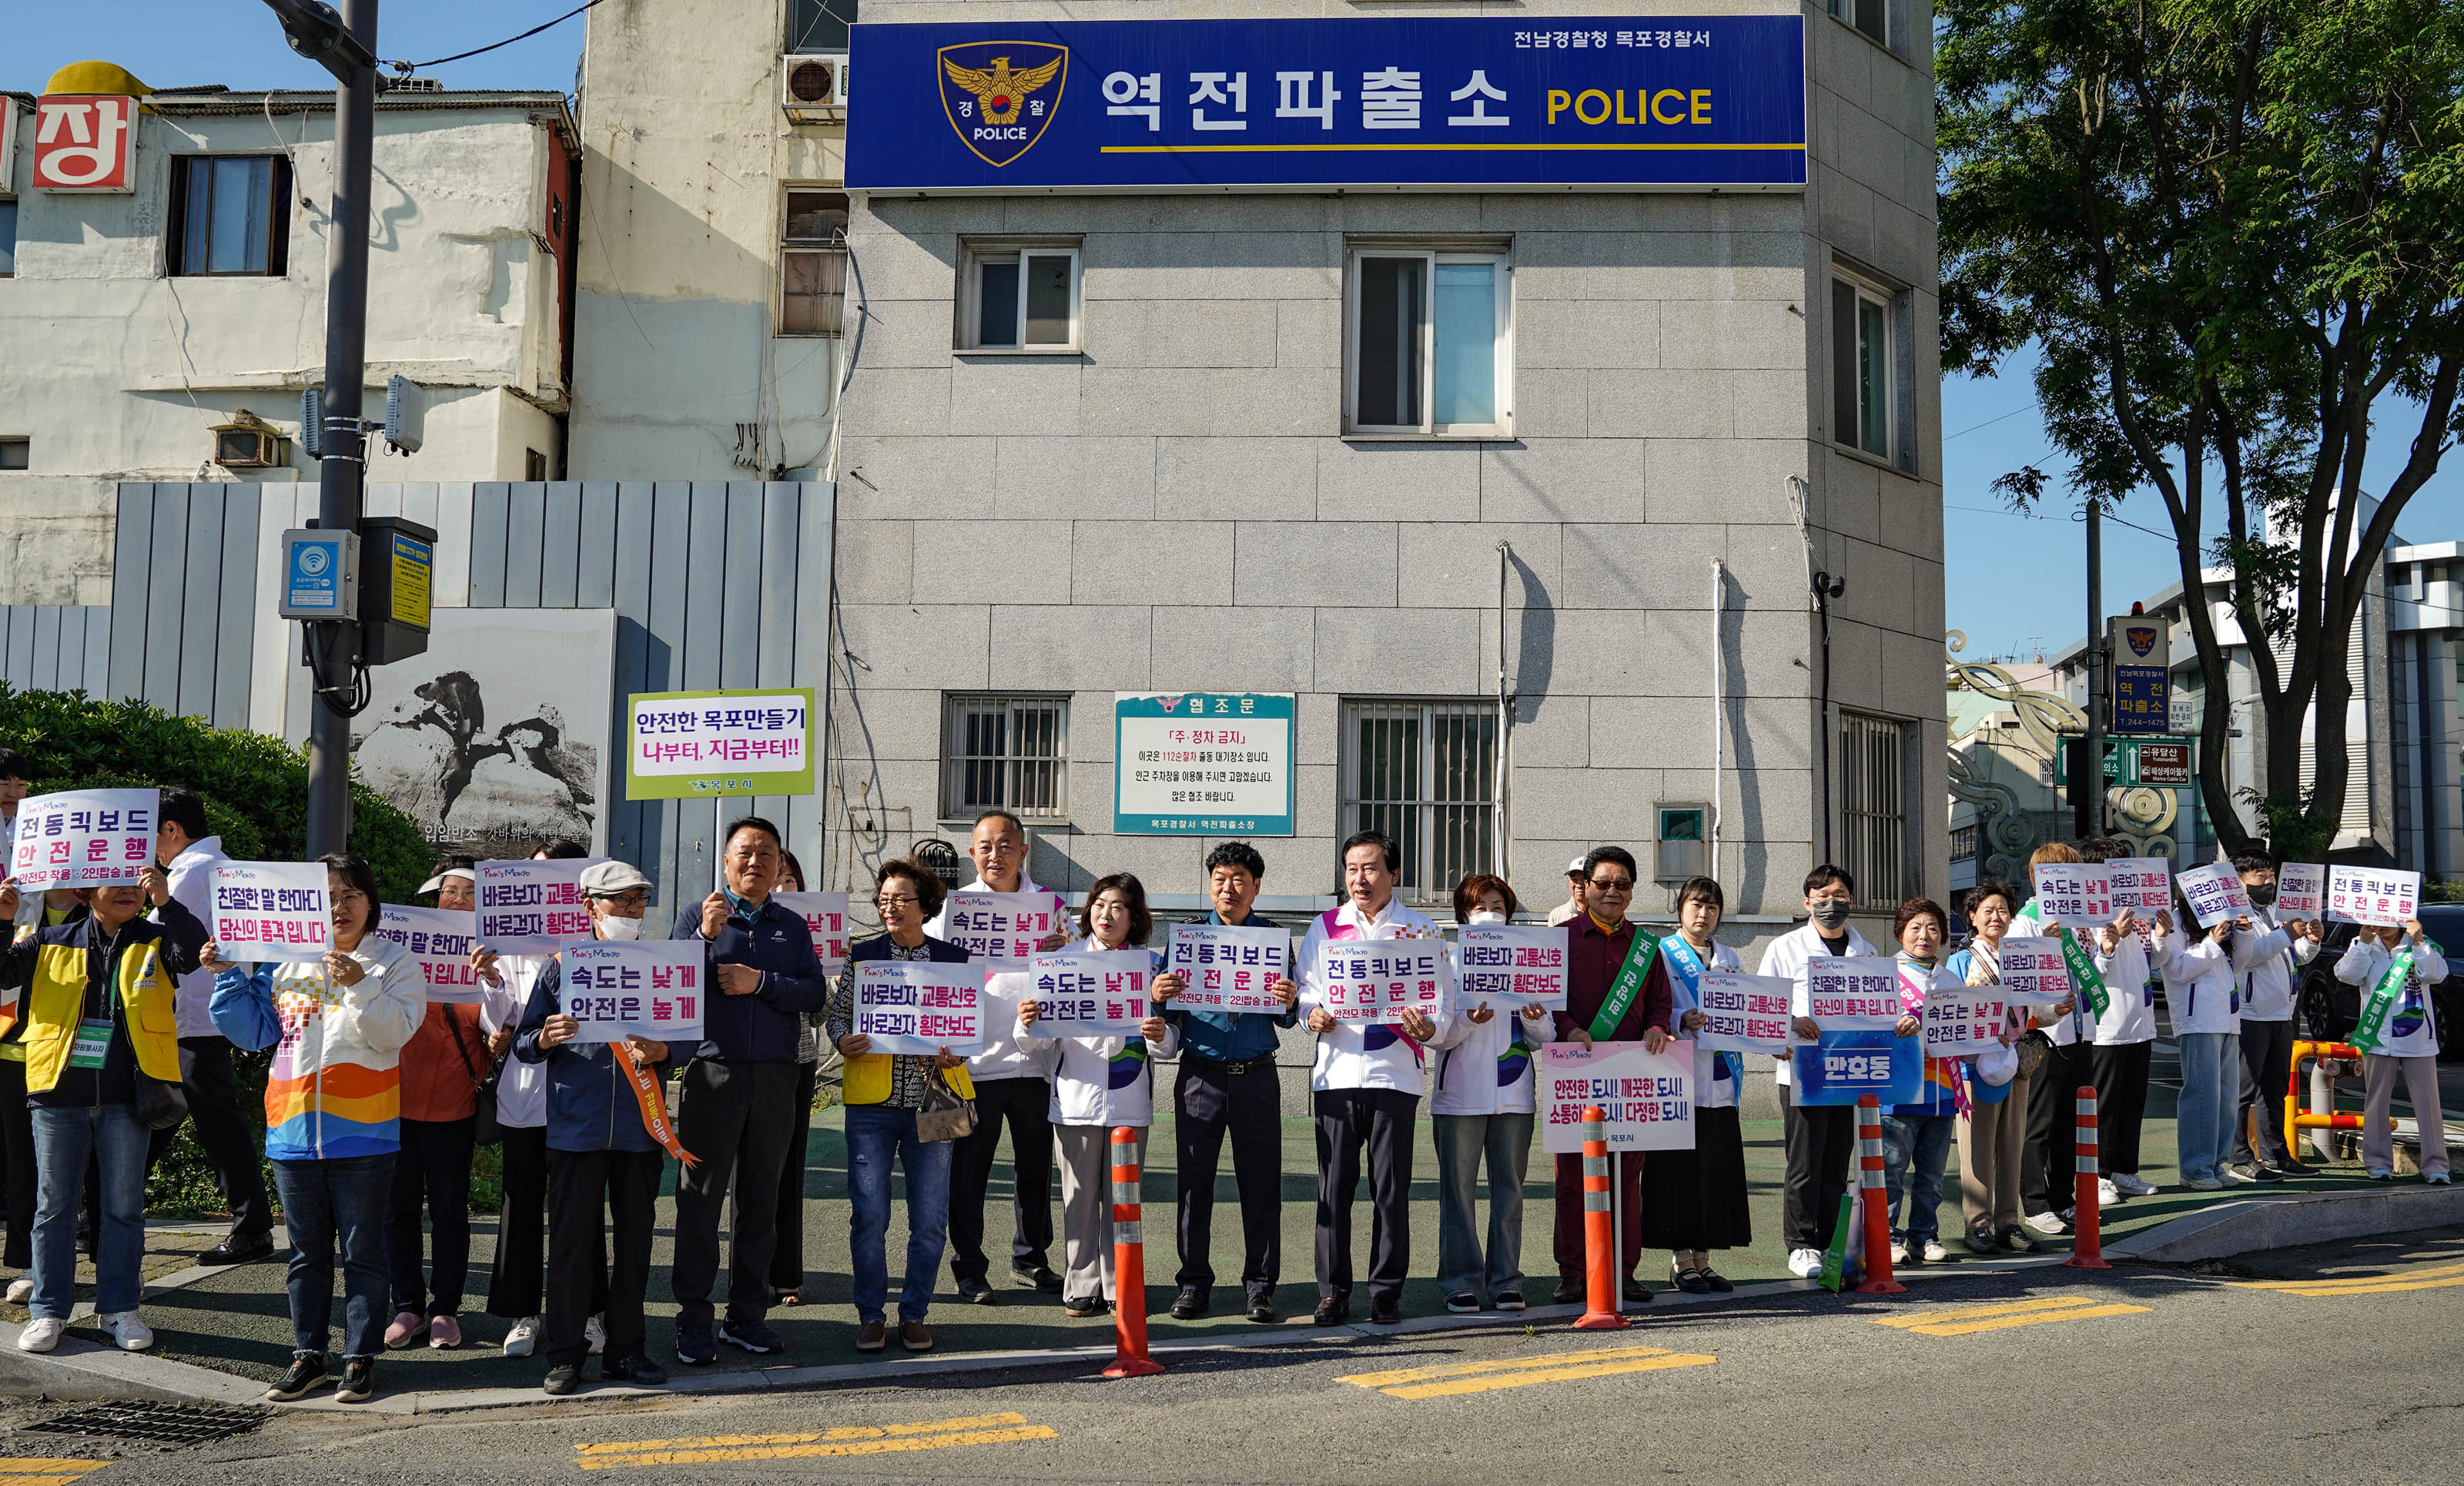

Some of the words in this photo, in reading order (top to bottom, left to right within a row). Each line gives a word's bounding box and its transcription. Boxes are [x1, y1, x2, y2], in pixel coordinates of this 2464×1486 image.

[1515, 31, 1608, 49] 전남경찰청
[1616, 31, 1709, 48] 목포경찰서
[959, 102, 972, 117] 경
[1030, 100, 1045, 115] 찰
[1548, 89, 1711, 125] POLICE
[974, 127, 1026, 140] POLICE
[1190, 698, 1254, 714] 협조문
[2120, 699, 2163, 713] 파출소
[637, 711, 698, 734] 안전한
[703, 708, 805, 731] 목포만들기
[643, 742, 703, 762] 나부터,
[709, 738, 798, 761] 지금부터!!
[1139, 751, 1160, 762] 이곳은
[1163, 751, 1197, 762] 112순찰차
[1200, 751, 1213, 762] 출동
[1216, 751, 1244, 763] 대기장소
[1247, 752, 1270, 763] 입니다.
[2151, 748, 2178, 757] 유달산
[1136, 771, 1149, 781] 인근
[1152, 771, 1179, 782] 주차장을
[1182, 771, 1203, 782] 이용해
[1206, 771, 1226, 782] 주시면
[1229, 771, 1272, 782] 고맙겠습니다.
[1172, 792, 1185, 802] 많은
[1188, 792, 1202, 802] 협조
[1205, 792, 1236, 802] 바랍니다.
[21, 810, 148, 841] 전동킥보드
[1151, 820, 1196, 828] 목포경찰서
[1201, 820, 1255, 829] 역전파출소장
[50, 869, 71, 881] 착용
[2111, 873, 2139, 888] 바로보자
[2140, 872, 2167, 887] 교통신호
[2282, 878, 2304, 892] 친절한
[483, 884, 542, 907] 바로보자
[2041, 879, 2081, 895] 속도는
[2085, 879, 2108, 895] 낮게
[2185, 879, 2220, 899] 바로보자
[2335, 879, 2413, 897] 전동킥보드
[218, 887, 259, 910] 친절한
[261, 888, 276, 911] 말
[279, 889, 322, 912] 한마디
[2044, 899, 2082, 915] 안전은
[2087, 899, 2109, 915] 높게
[2111, 892, 2141, 908] 바로걷자
[2142, 892, 2168, 907] 횡단보도
[2194, 895, 2228, 916] 바로걷자
[2278, 895, 2299, 910] 당신의
[219, 919, 259, 942] 당신의
[261, 919, 286, 942] 품격
[286, 921, 325, 944] 입니다
[483, 914, 543, 936] 바로걷자
[547, 912, 591, 935] 횡단보
[952, 912, 1007, 932] 속도는
[1016, 912, 1048, 932] 낮게
[411, 932, 429, 954] 말
[1176, 942, 1282, 966] 전동킥보드
[1464, 946, 1513, 967] 바로보자
[1515, 946, 1562, 968] 교통신호
[2003, 955, 2036, 971] 바로보자
[2038, 954, 2065, 971] 교통신호
[435, 962, 480, 986] 입니다
[571, 966, 641, 989] 속도는
[651, 966, 695, 989] 낮게
[1327, 956, 1435, 980] 전동킥보드
[1037, 973, 1096, 993] 속도는
[1105, 972, 1143, 992] 낮게
[1462, 973, 1511, 993] 바로걷자
[1513, 973, 1561, 993] 횡단보도
[1812, 975, 1846, 993] 친절한
[1849, 976, 1860, 993] 말
[1862, 975, 1894, 993] 한마디
[2004, 976, 2037, 992] 바로걷자
[2039, 975, 2069, 992] 횡단보도
[861, 984, 918, 1006] 바로보자
[920, 986, 977, 1009] 교통신호
[1178, 994, 1202, 1003] 안전모
[1205, 994, 1221, 1004] 착용
[1703, 991, 1745, 1012] 바로보자
[1747, 994, 1787, 1015] 교통신호
[571, 997, 640, 1022] 안전은
[651, 996, 695, 1020] 높게
[1039, 1000, 1096, 1021] 안전은
[1106, 999, 1143, 1019] 높게
[1334, 1008, 1358, 1019] 안전모
[1361, 1008, 1378, 1018] 착용
[1813, 998, 1843, 1016] 당신의
[1846, 998, 1866, 1016] 품격
[1868, 998, 1897, 1016] 입니다
[1928, 1002, 1969, 1021] 속도는
[1974, 1002, 2003, 1018] 낮게
[860, 1012, 916, 1036] 바로걷자
[919, 1014, 976, 1037] 횡단보도
[1703, 1016, 1745, 1036] 바로걷자
[1746, 1019, 1786, 1039] 횡단보도
[1927, 1024, 1967, 1044] 안전은
[1973, 1022, 2000, 1039] 높게
[1825, 1056, 1890, 1080] 만호동
[1555, 1079, 1589, 1099] 안전한
[1592, 1079, 1617, 1098] 도시!
[1621, 1078, 1654, 1098] 깨끗한
[1657, 1078, 1682, 1097] 도시!
[1549, 1103, 1586, 1124] 소통하
[1626, 1102, 1659, 1122] 다정한
[1662, 1101, 1687, 1121] 도시!
